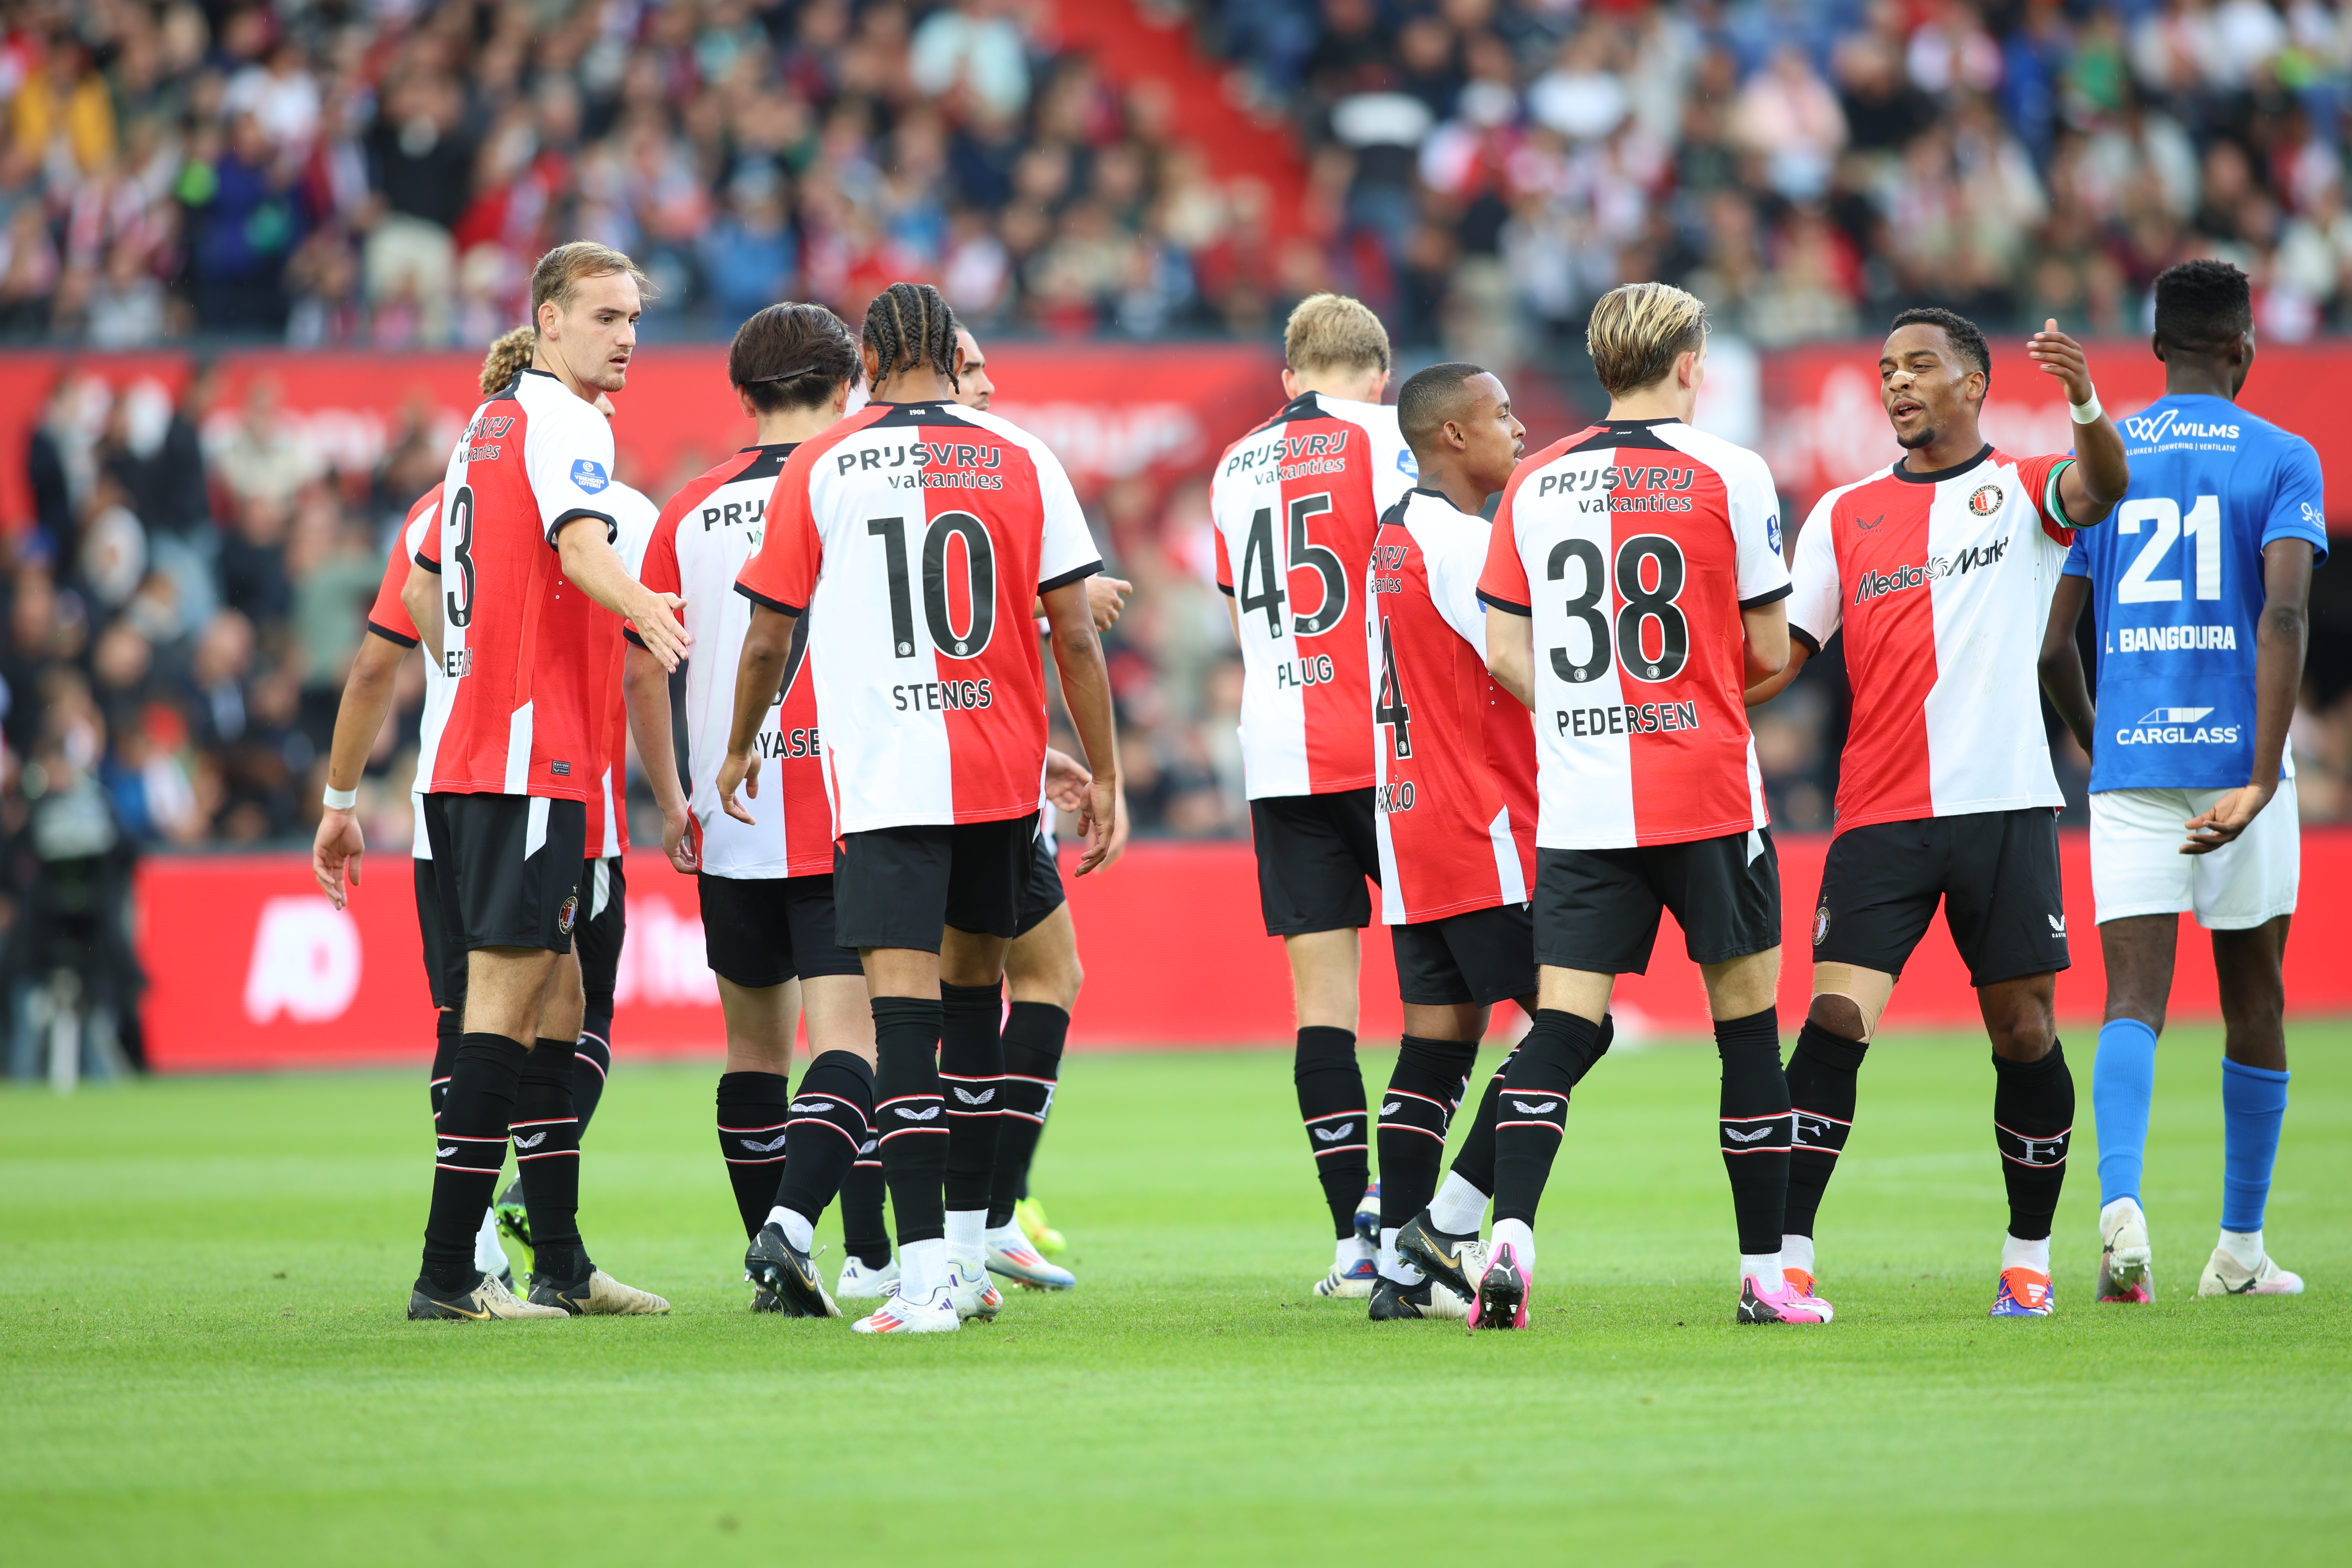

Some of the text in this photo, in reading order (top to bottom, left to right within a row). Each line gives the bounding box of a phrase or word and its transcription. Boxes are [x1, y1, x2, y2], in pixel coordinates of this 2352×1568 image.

[2171, 422, 2240, 439] WILMS
[2126, 443, 2237, 456] LLUIKEN ZONWERING VENTILATIE
[574, 474, 604, 485] VRIENDEN
[578, 480, 601, 489] LOTERIJ
[887, 469, 1003, 490] vakanties
[1255, 457, 1345, 486] vakanties
[1578, 493, 1693, 513] vakanties
[1970, 486, 2000, 501] FEYENOORD
[1971, 499, 2002, 516] ROTTERDAM
[1856, 529, 1882, 537] CASTORE
[447, 485, 475, 628] 3
[2118, 495, 2221, 604] 21
[1241, 492, 1348, 639] 45
[867, 510, 996, 660] 10
[1547, 534, 1690, 683] 38
[2120, 626, 2236, 652] BANGOURA
[1277, 653, 1335, 690] PLUG
[893, 678, 993, 711] STENGS
[1556, 701, 1699, 737] PEDERSEN
[754, 728, 820, 759] YASE
[2017, 1137, 2063, 1164] F
